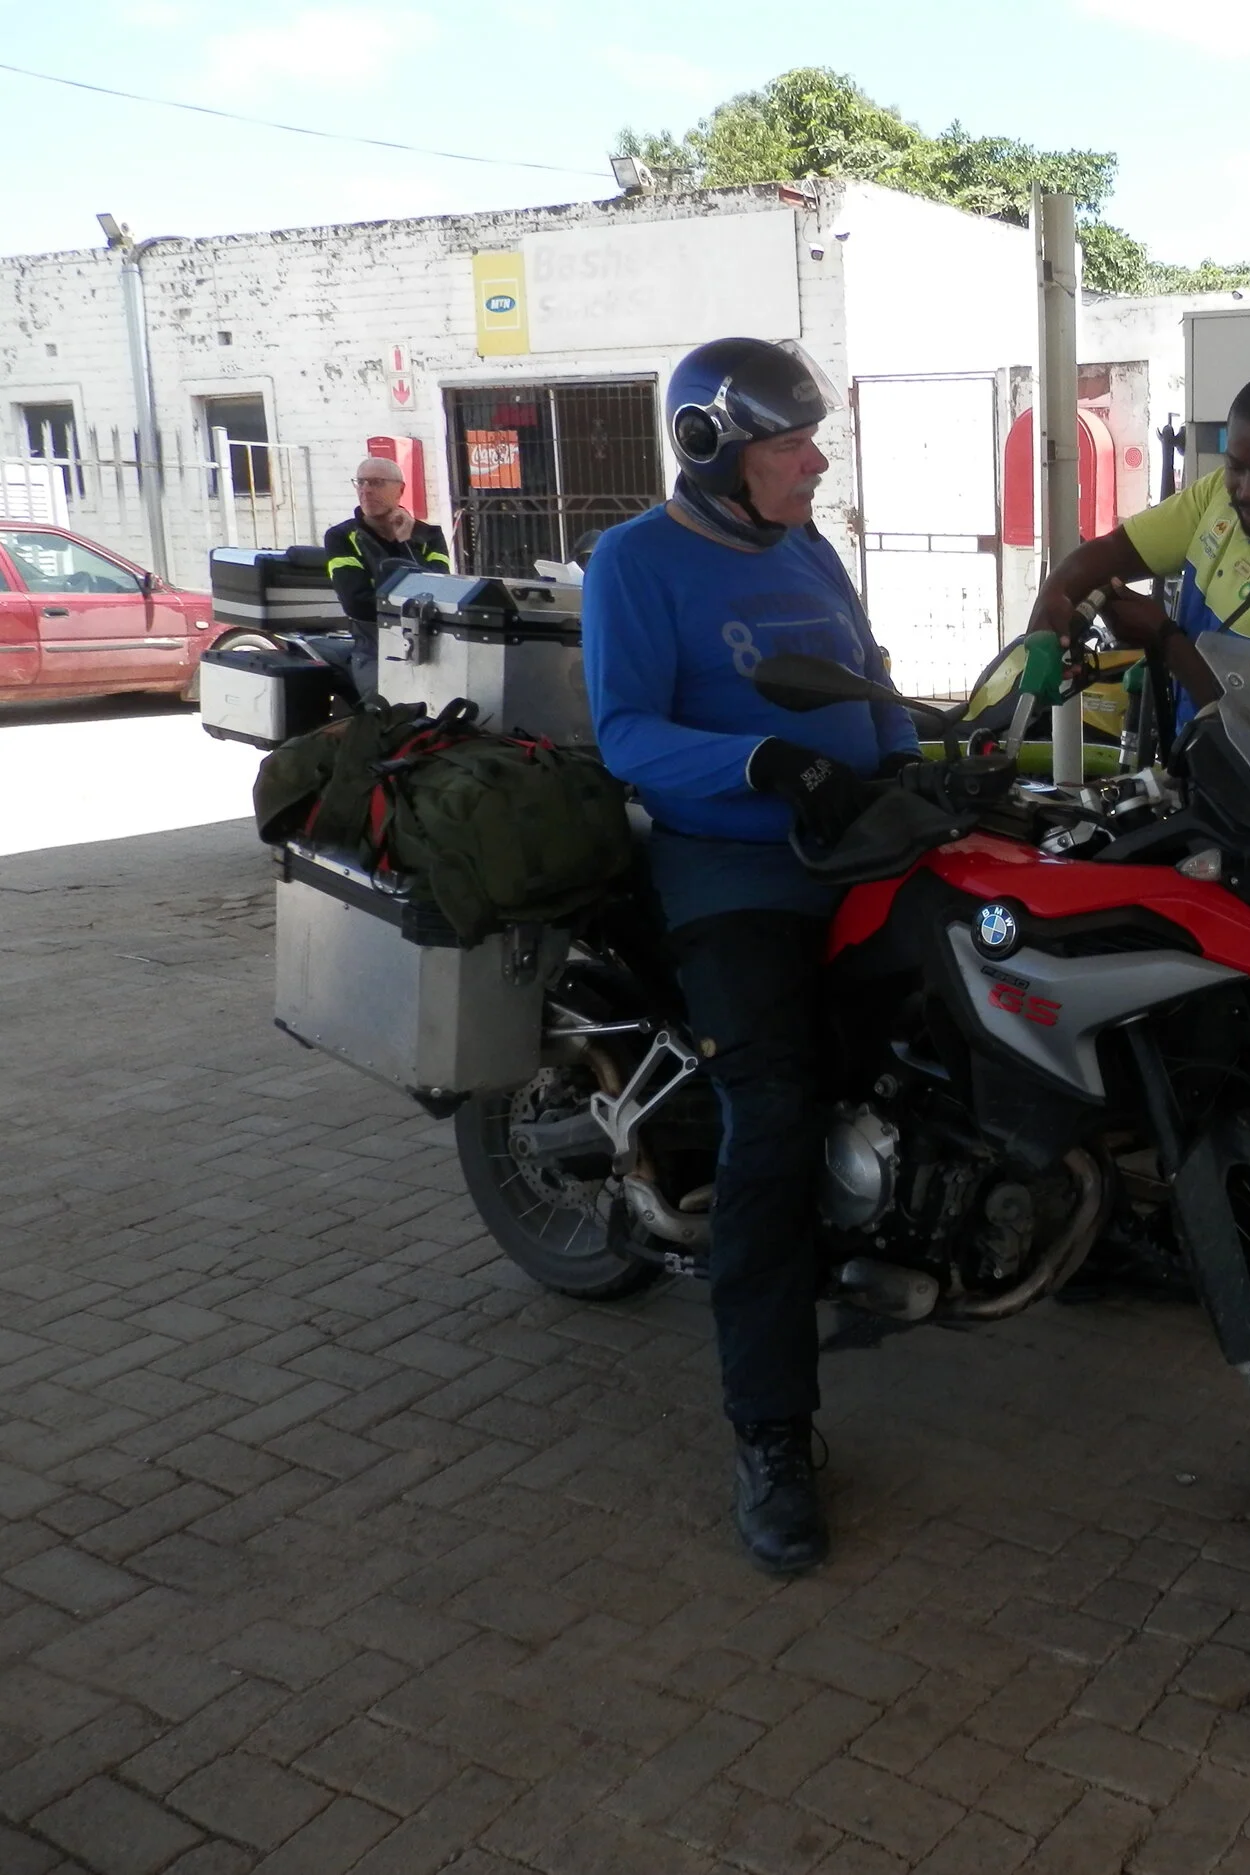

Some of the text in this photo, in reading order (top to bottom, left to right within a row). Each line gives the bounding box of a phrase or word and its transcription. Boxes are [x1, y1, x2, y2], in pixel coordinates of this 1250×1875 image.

[490, 298, 510, 310] MTN
[982, 907, 1013, 926] BMW
[987, 983, 1062, 1026] GS
